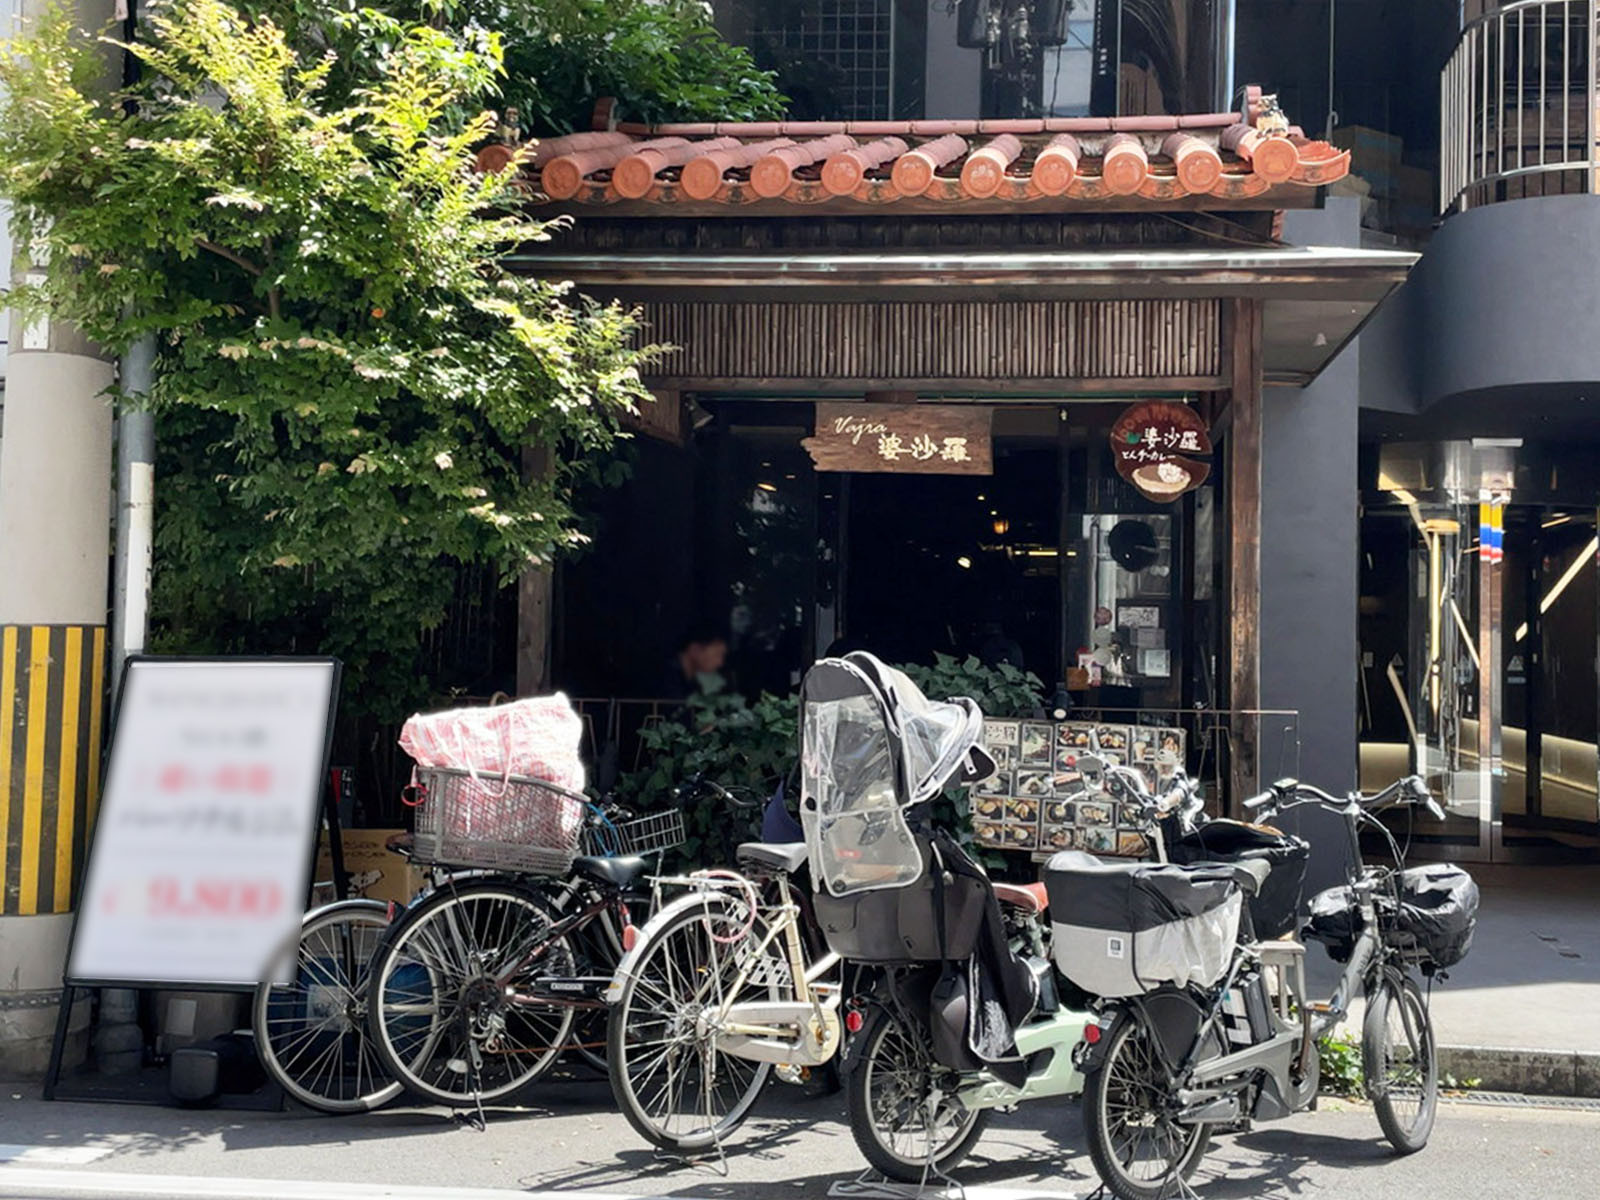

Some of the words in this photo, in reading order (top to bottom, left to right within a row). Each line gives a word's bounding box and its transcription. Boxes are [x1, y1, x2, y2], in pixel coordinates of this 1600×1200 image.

[834, 415, 888, 445] Vajra
[878, 432, 972, 463] 婆沙羅
